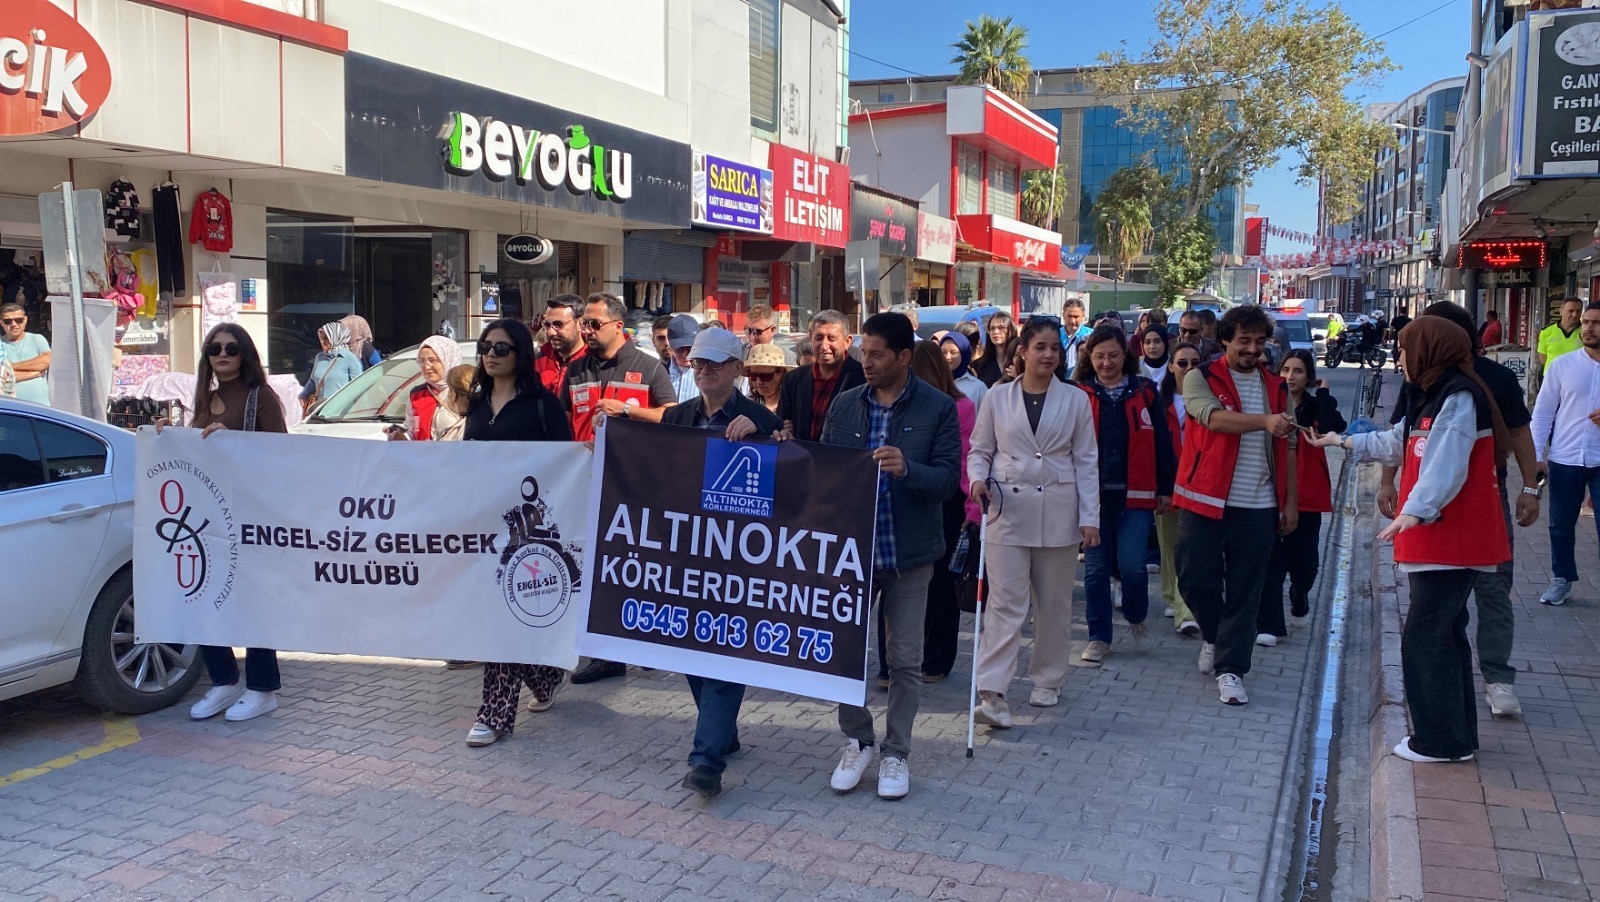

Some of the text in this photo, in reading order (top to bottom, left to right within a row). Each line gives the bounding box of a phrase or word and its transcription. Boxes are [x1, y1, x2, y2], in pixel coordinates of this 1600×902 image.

[1561, 73, 1600, 90] G.AN
[709, 163, 759, 198] SARICA
[792, 156, 830, 196] ELİT
[785, 190, 843, 236] İLETİŞİM
[193, 466, 226, 506] KORKUT
[221, 507, 234, 531] ATA
[338, 493, 396, 521] OKÜ
[703, 502, 769, 517] KÖRLERDERNEĞİ
[704, 493, 770, 510] ALTINOKTA
[240, 523, 499, 555] ENGEL-SİZ GELECEK
[604, 503, 865, 583] ALTINOKTA
[313, 560, 419, 586] KULÜBÜ
[516, 575, 559, 593] ENGEL-SİZ
[600, 551, 864, 626] KÖRLERDERNEĞİ
[621, 598, 833, 663] 0545 813 62 75
